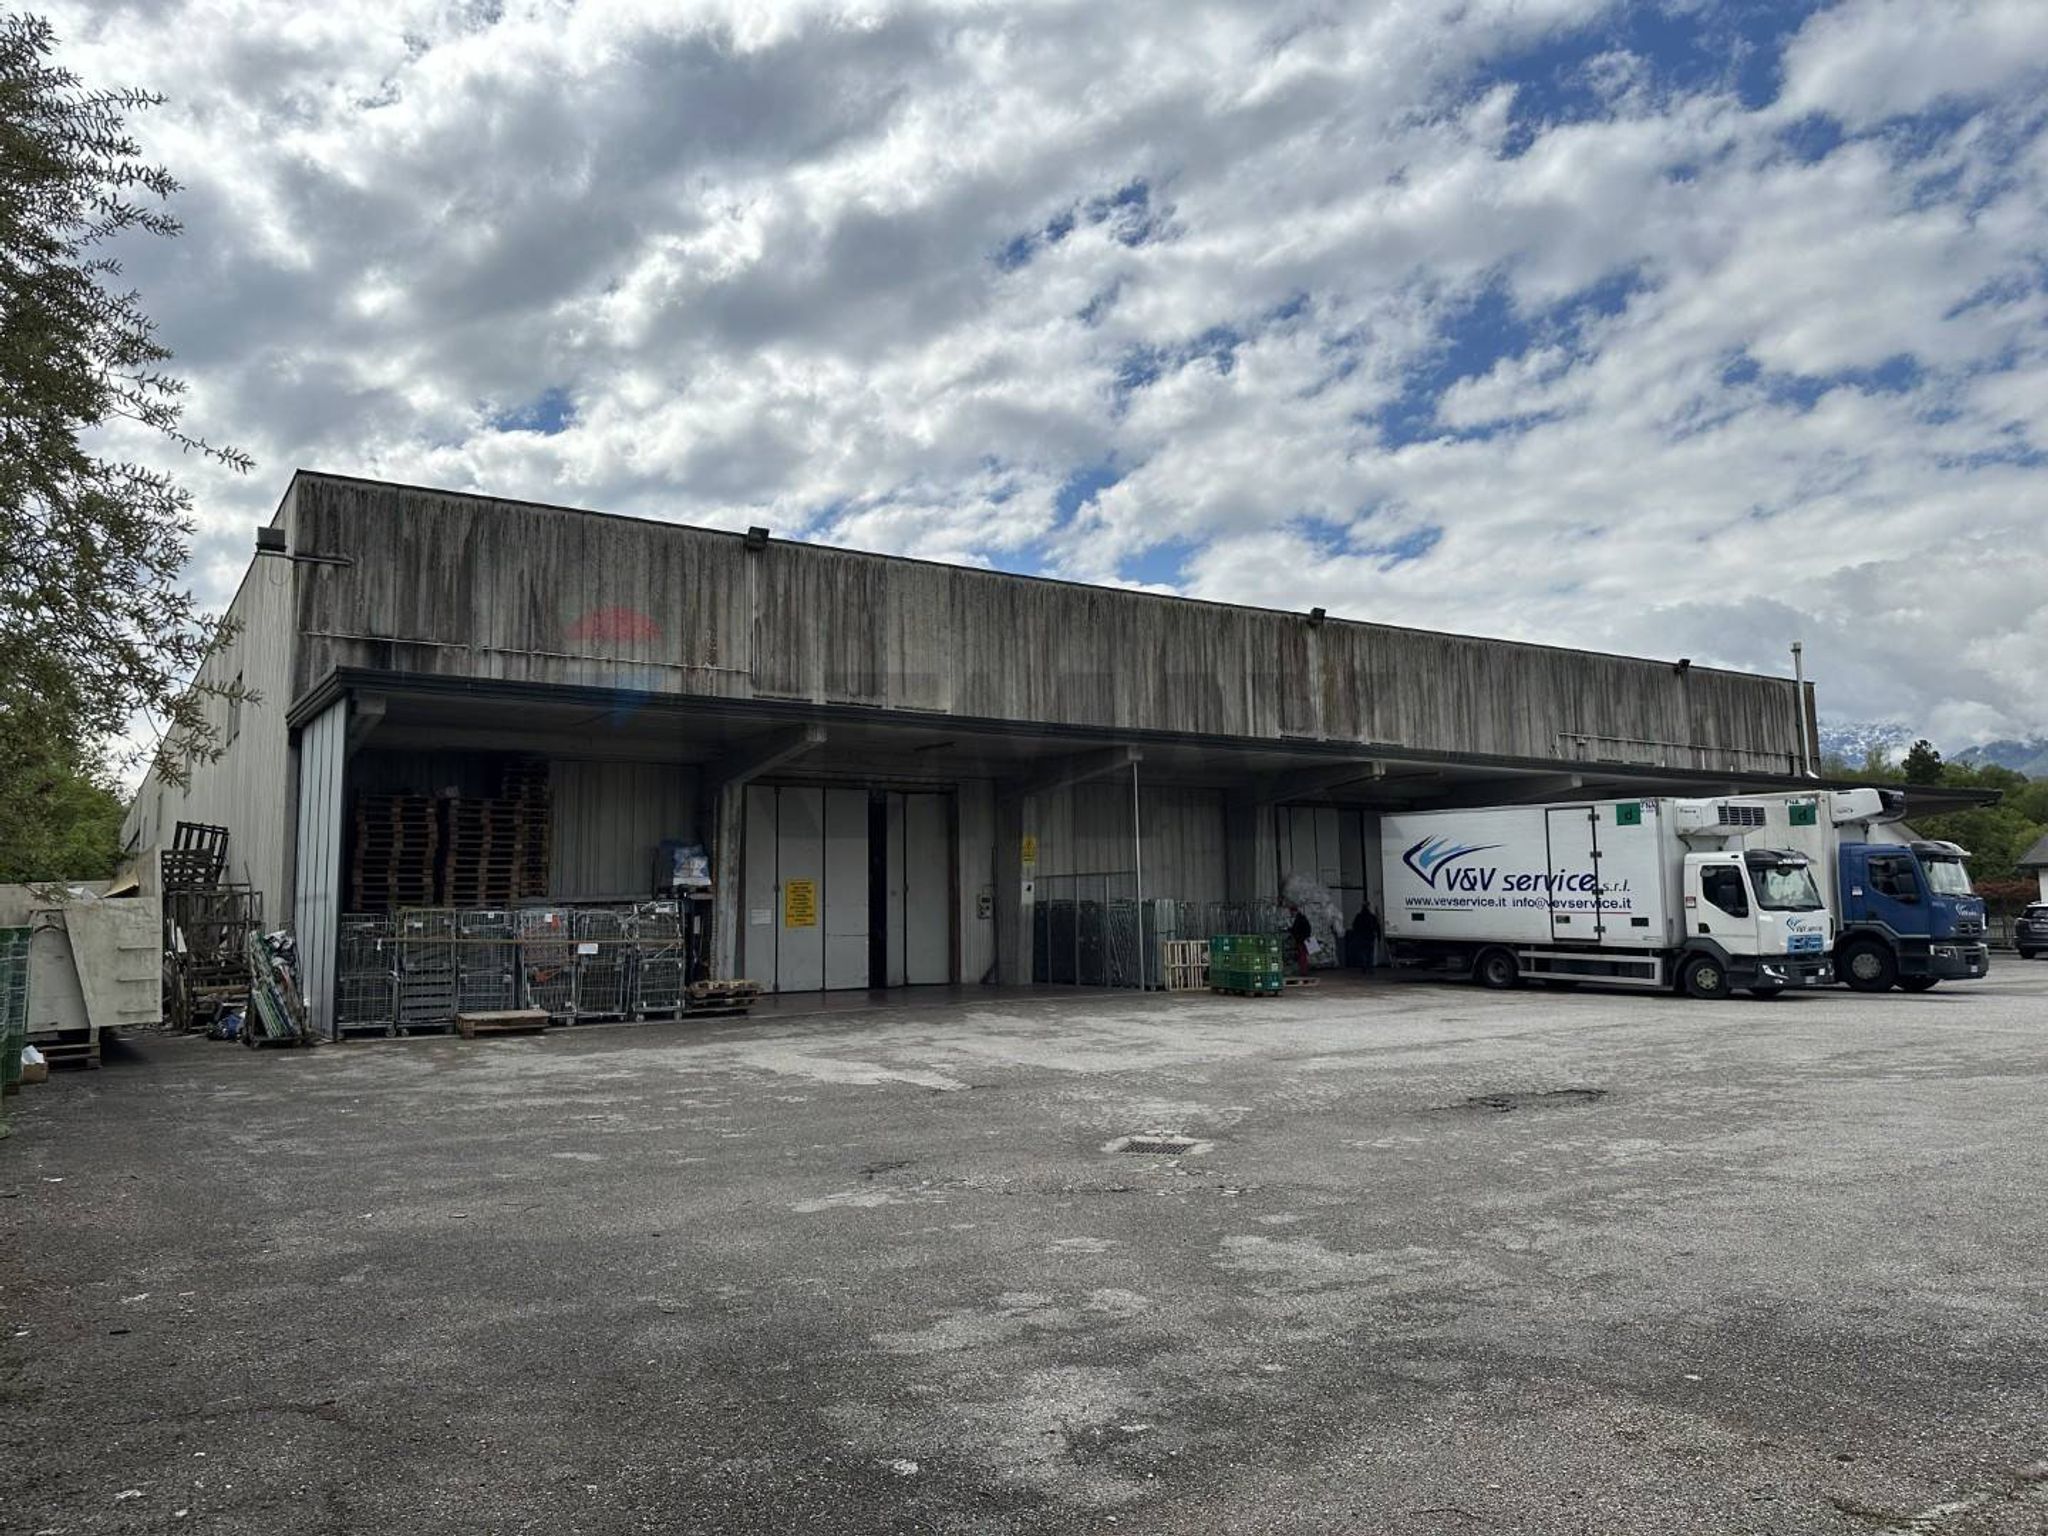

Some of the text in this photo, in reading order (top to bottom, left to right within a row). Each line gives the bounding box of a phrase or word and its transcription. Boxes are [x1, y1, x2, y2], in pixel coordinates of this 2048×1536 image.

[1625, 807, 1632, 820] d
[1446, 867, 1631, 892] V&V service s.r.l.
[1405, 896, 1632, 910] www.vevservice.it info@vevservice.it
